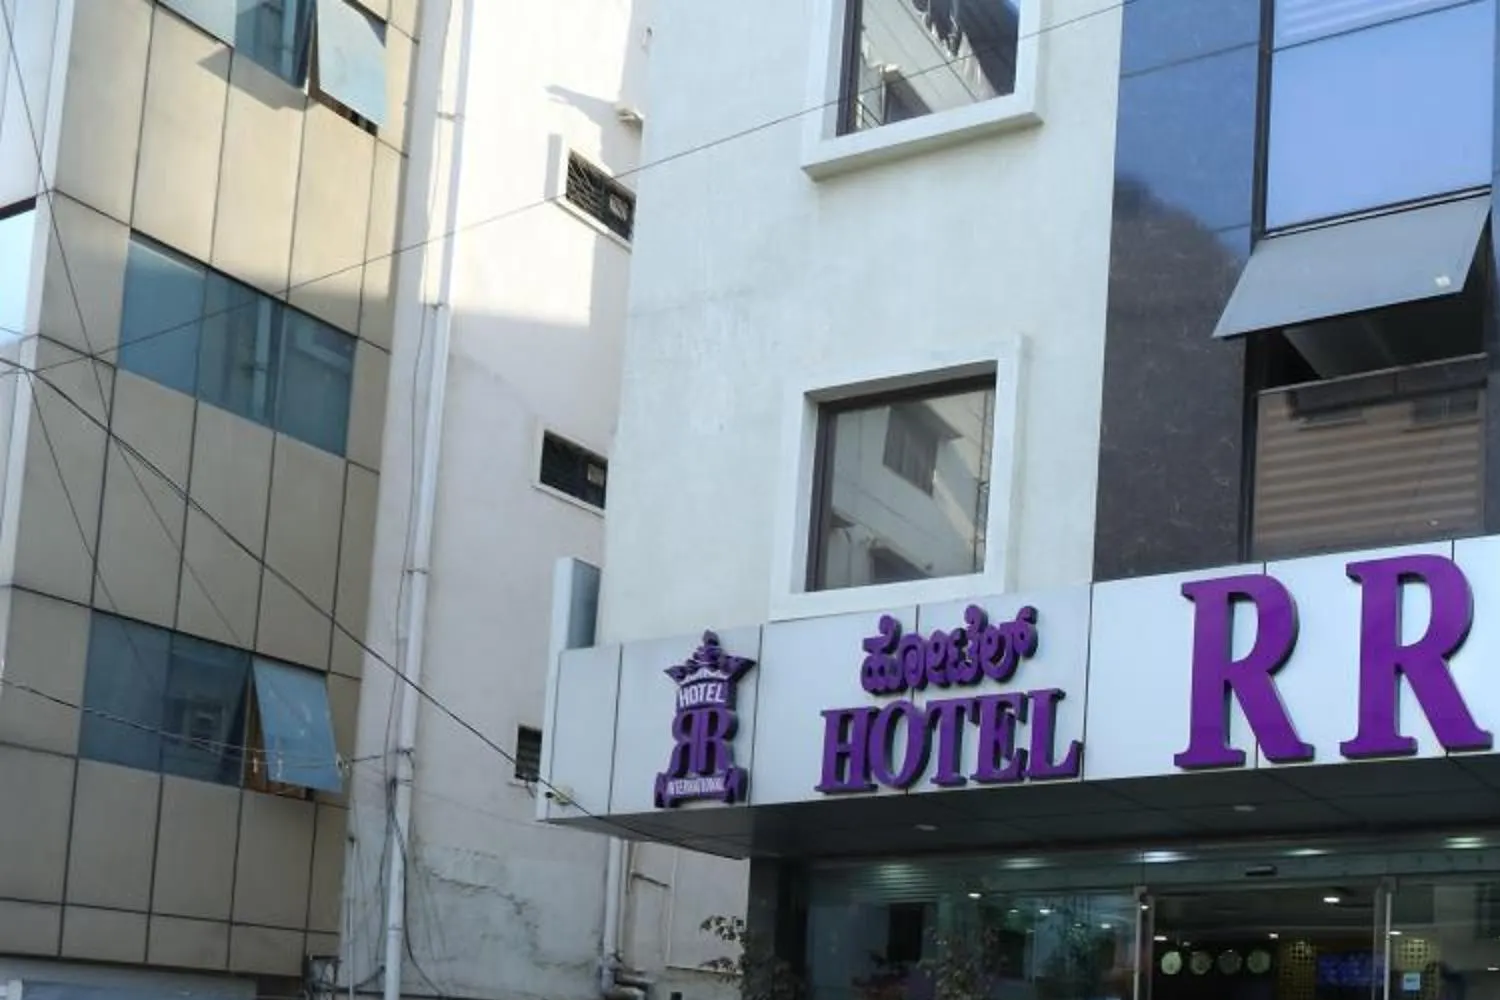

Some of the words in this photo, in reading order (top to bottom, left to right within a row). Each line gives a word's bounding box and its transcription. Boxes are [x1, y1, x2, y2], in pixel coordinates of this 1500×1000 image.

[679, 683, 725, 706] HOTEL
[814, 688, 1084, 795] HOTEL
[1174, 554, 1494, 770] RR
